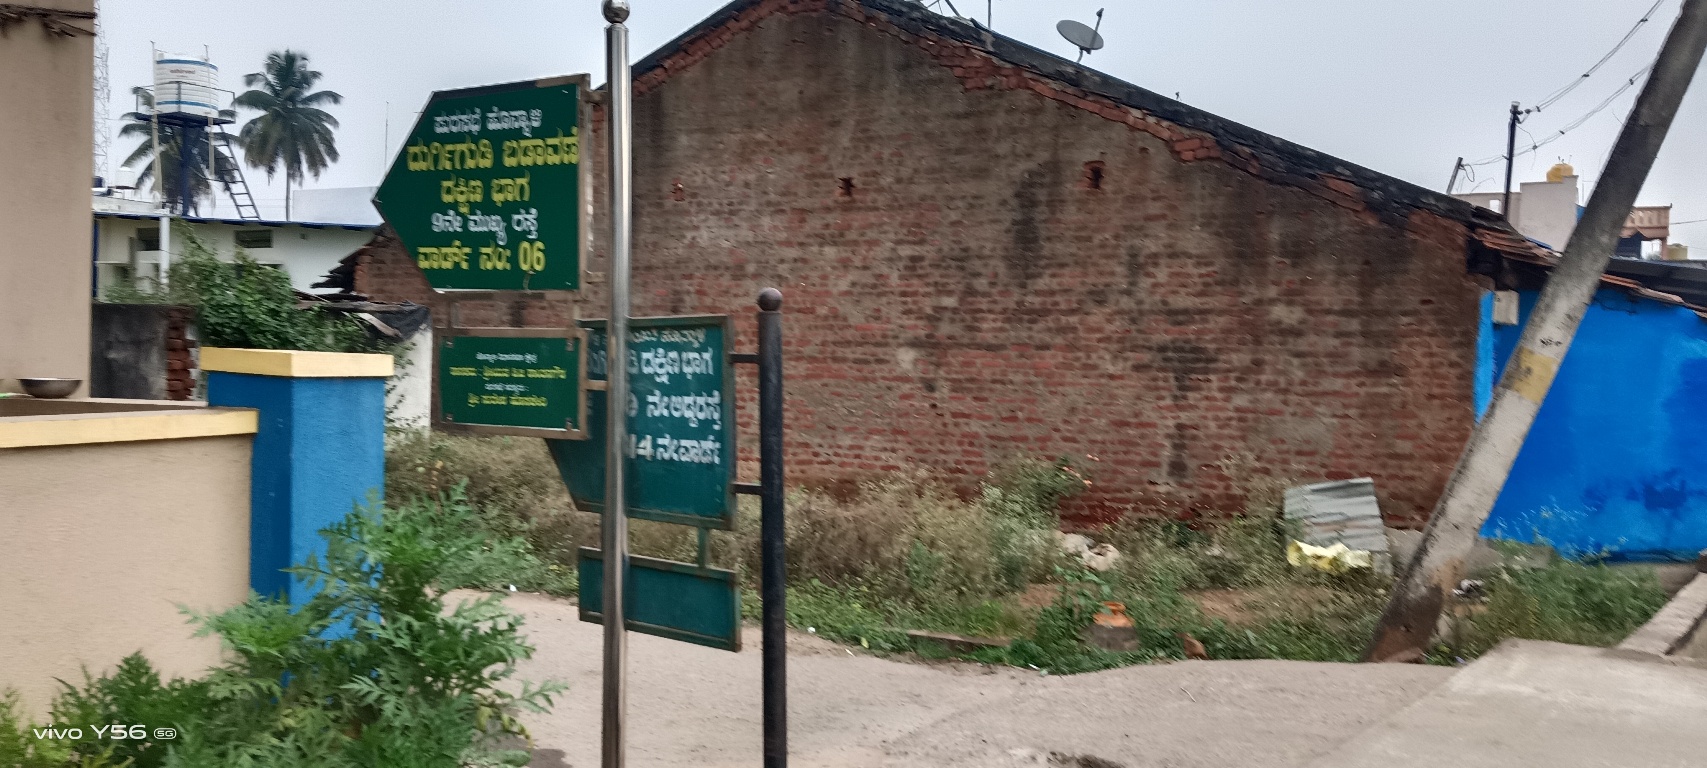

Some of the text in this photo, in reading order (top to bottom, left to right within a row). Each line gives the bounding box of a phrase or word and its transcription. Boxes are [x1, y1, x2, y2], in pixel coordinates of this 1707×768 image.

[502, 126, 579, 167] ಬಡಾವಣೆ
[440, 170, 530, 215] ದಕ್ಷಿಣ ಭಾಗ
[467, 208, 507, 246] ಮುಖ್ಯ
[511, 207, 539, 239] ರಸ್ತೆ
[517, 239, 546, 272] 06
[681, 346, 714, 380] ಭಾಗ
